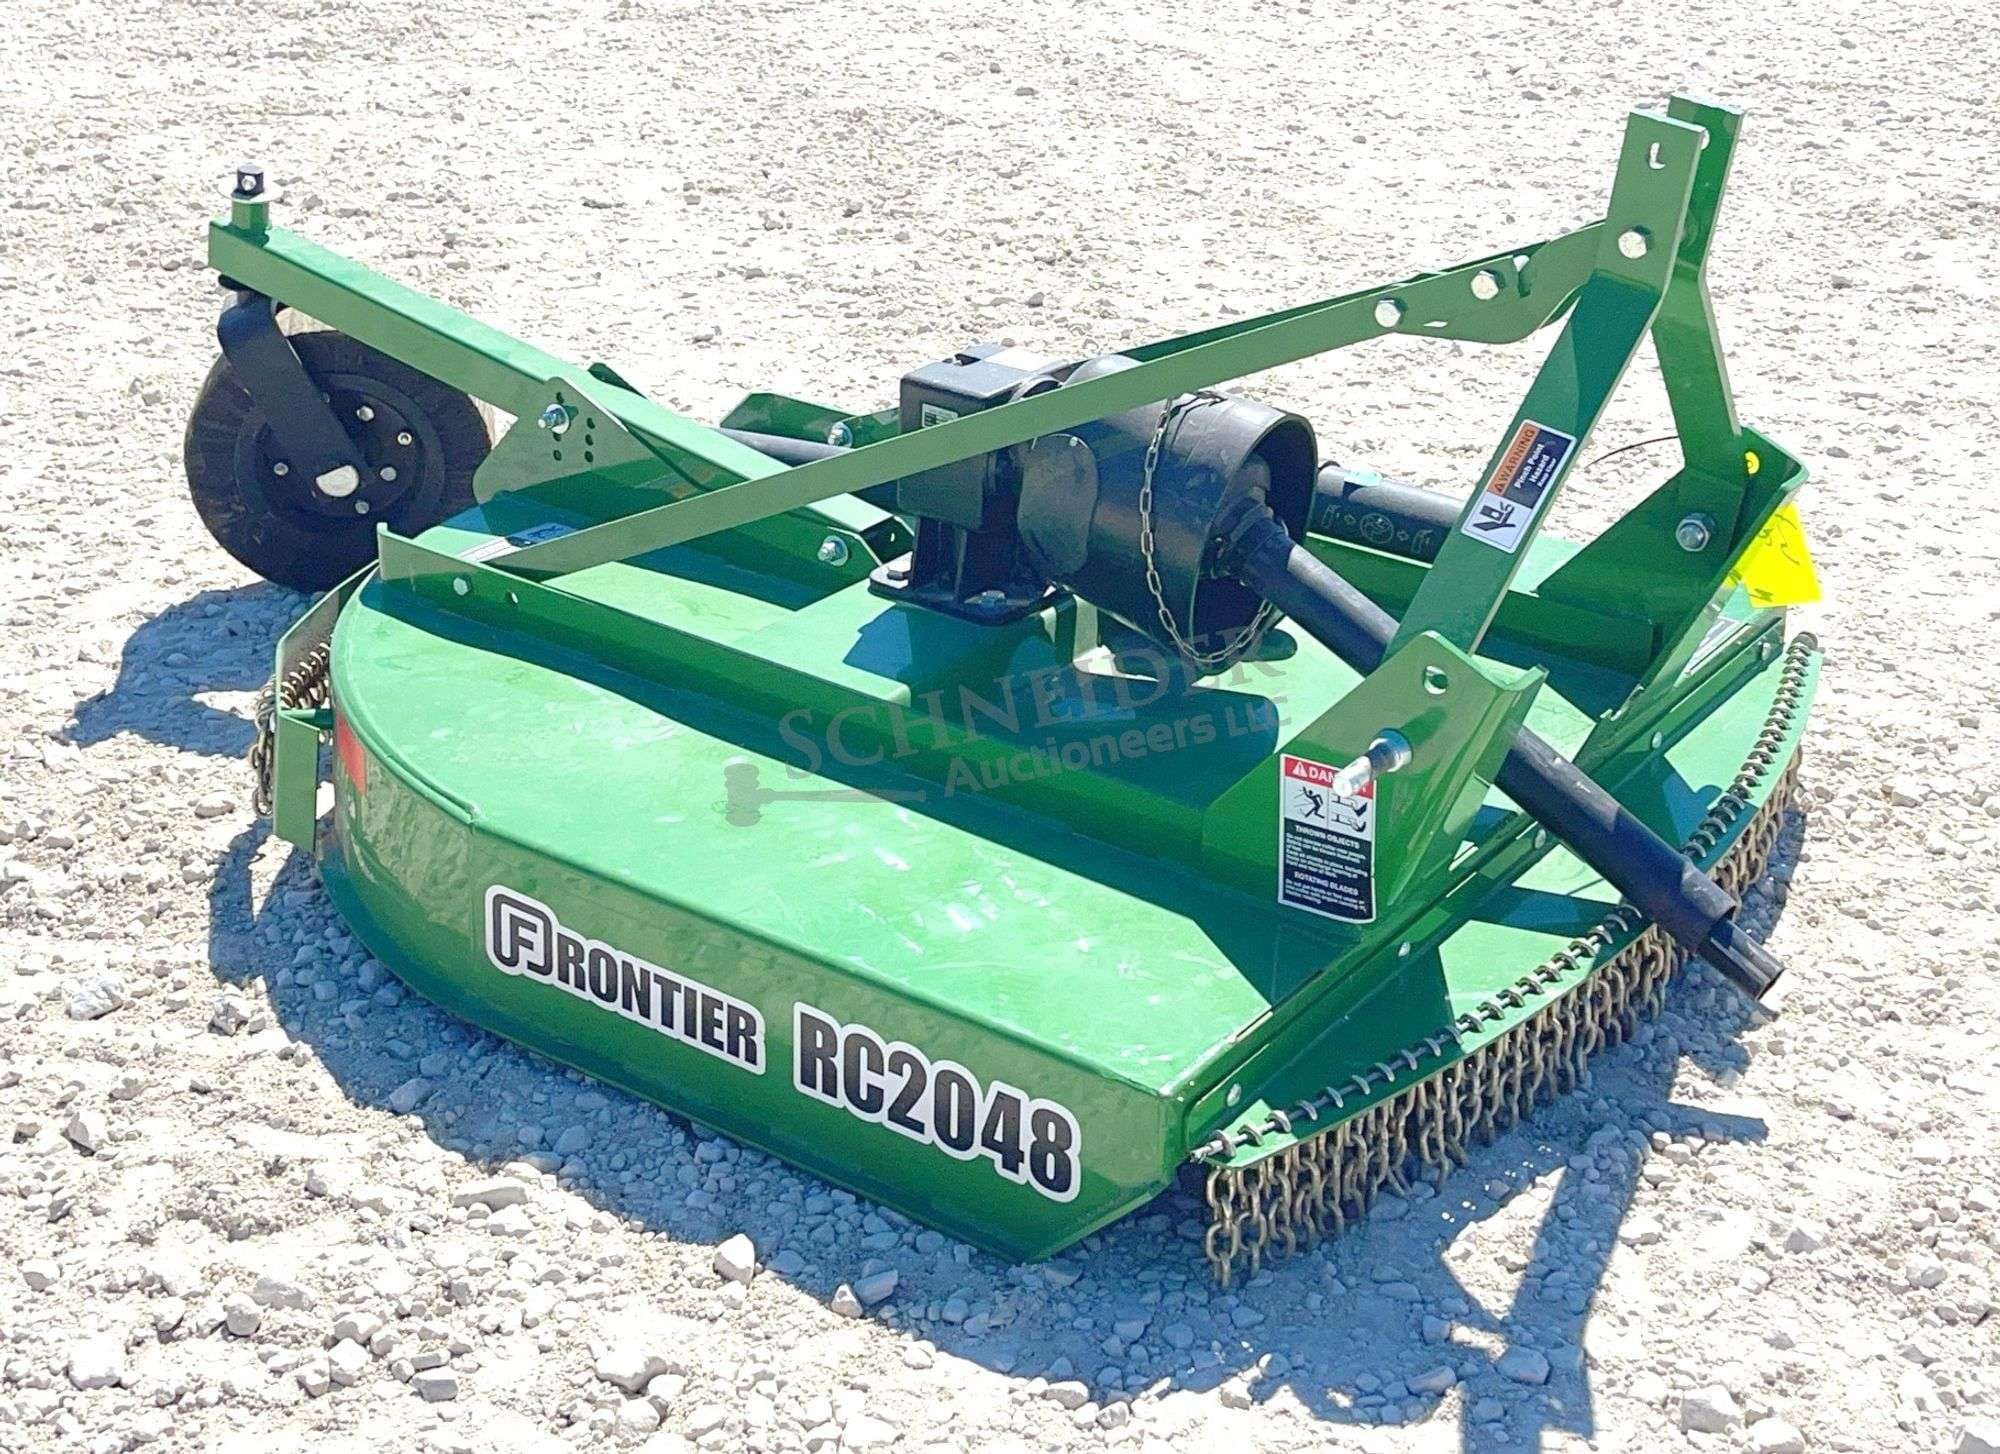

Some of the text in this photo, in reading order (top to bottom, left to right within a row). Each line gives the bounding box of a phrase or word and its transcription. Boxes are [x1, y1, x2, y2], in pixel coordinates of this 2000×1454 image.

[1498, 429, 1535, 482] WARNING
[1527, 443, 1545, 465] Point
[1529, 454, 1550, 482] Hazard
[1295, 824, 1360, 849] THROWN OBJECTS
[1294, 871, 1329, 887] ROTATING
[1329, 881, 1359, 897] BLADES
[492, 893, 1074, 1194] FRONTIER RC2048
